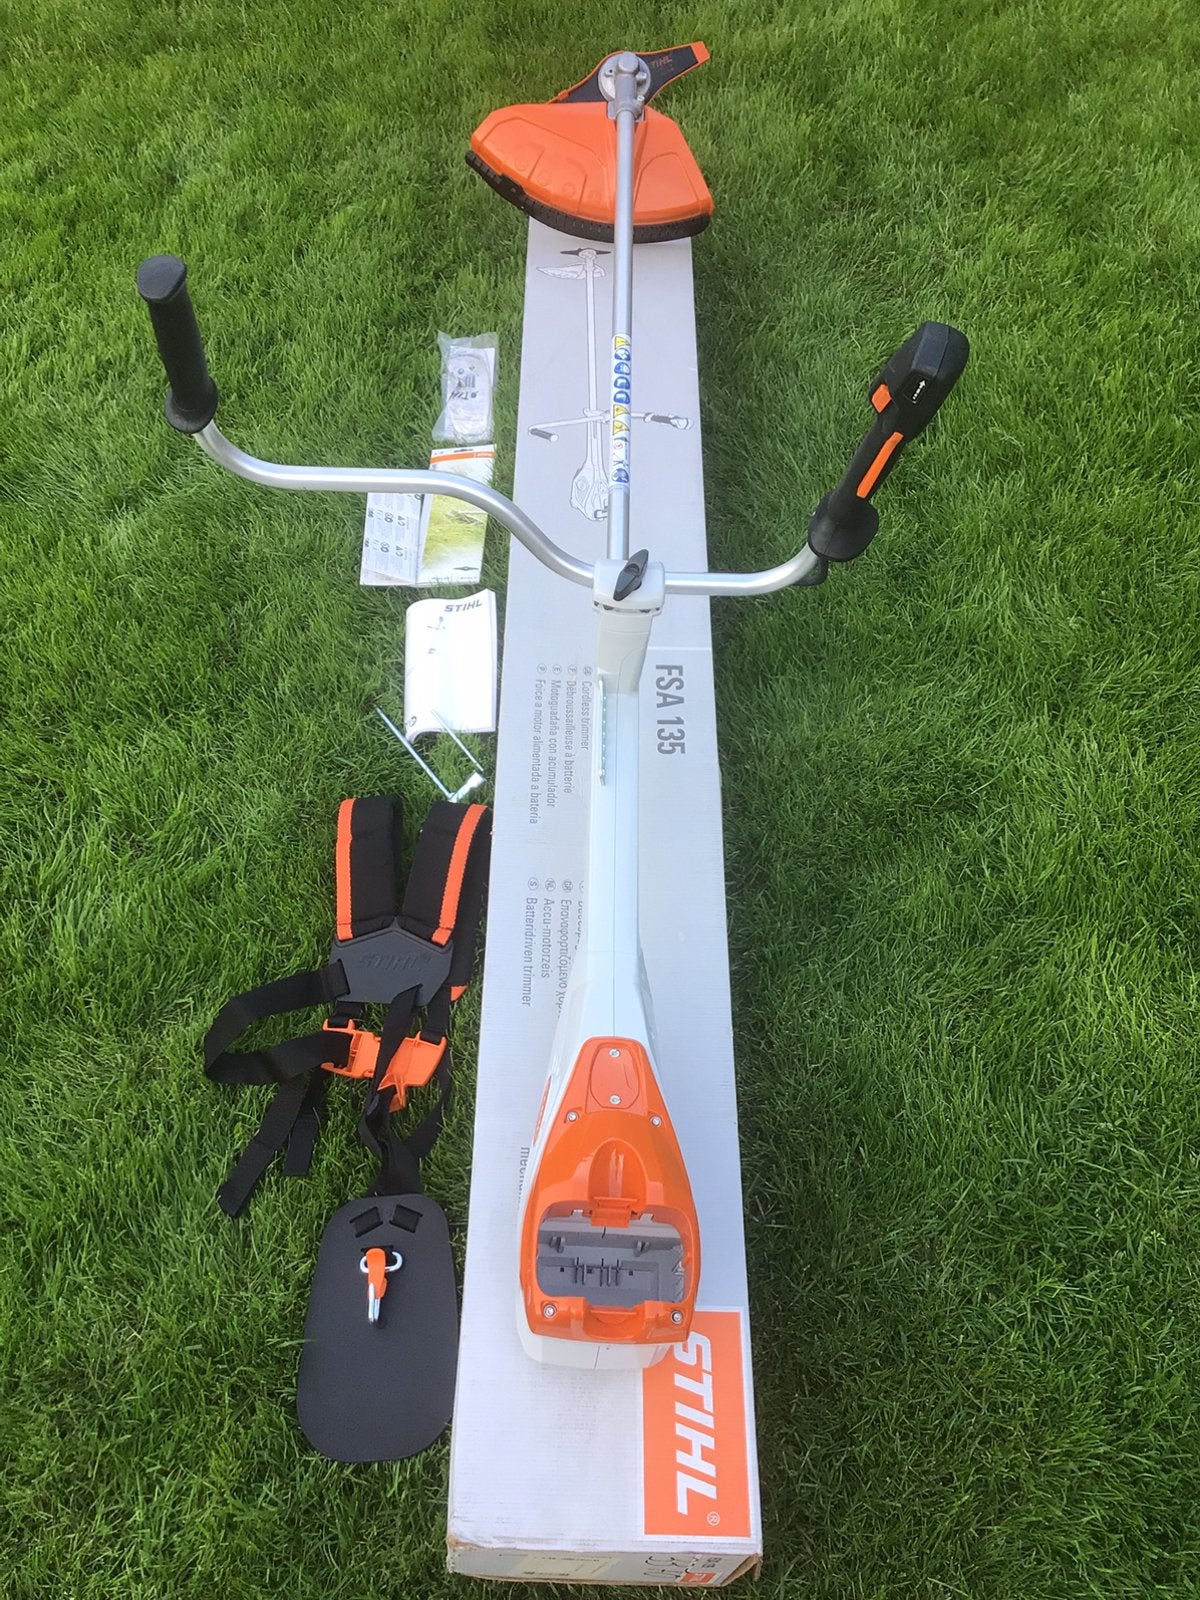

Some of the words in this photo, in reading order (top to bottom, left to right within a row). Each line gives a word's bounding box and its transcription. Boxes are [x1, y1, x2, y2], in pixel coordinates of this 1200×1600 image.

[444, 599, 482, 612] STIHL
[534, 679, 546, 700] Foice
[581, 681, 593, 716] Cordless
[655, 664, 685, 708] FSA
[533, 710, 544, 733] motor
[547, 680, 562, 736] Motoguadaña
[563, 680, 577, 751] Débroussailleuse
[548, 738, 558, 754] con
[580, 718, 591, 751] trimmer
[656, 716, 686, 754] 135
[531, 735, 543, 782] alimentada
[563, 760, 575, 794] batterie
[546, 756, 559, 808] acumulador
[529, 792, 541, 824] bateria
[523, 897, 537, 963] Batteridriven
[541, 898, 555, 978] Accu-motorzeis
[522, 965, 534, 1007] trimmer
[673, 1331, 717, 1515] STIHL
